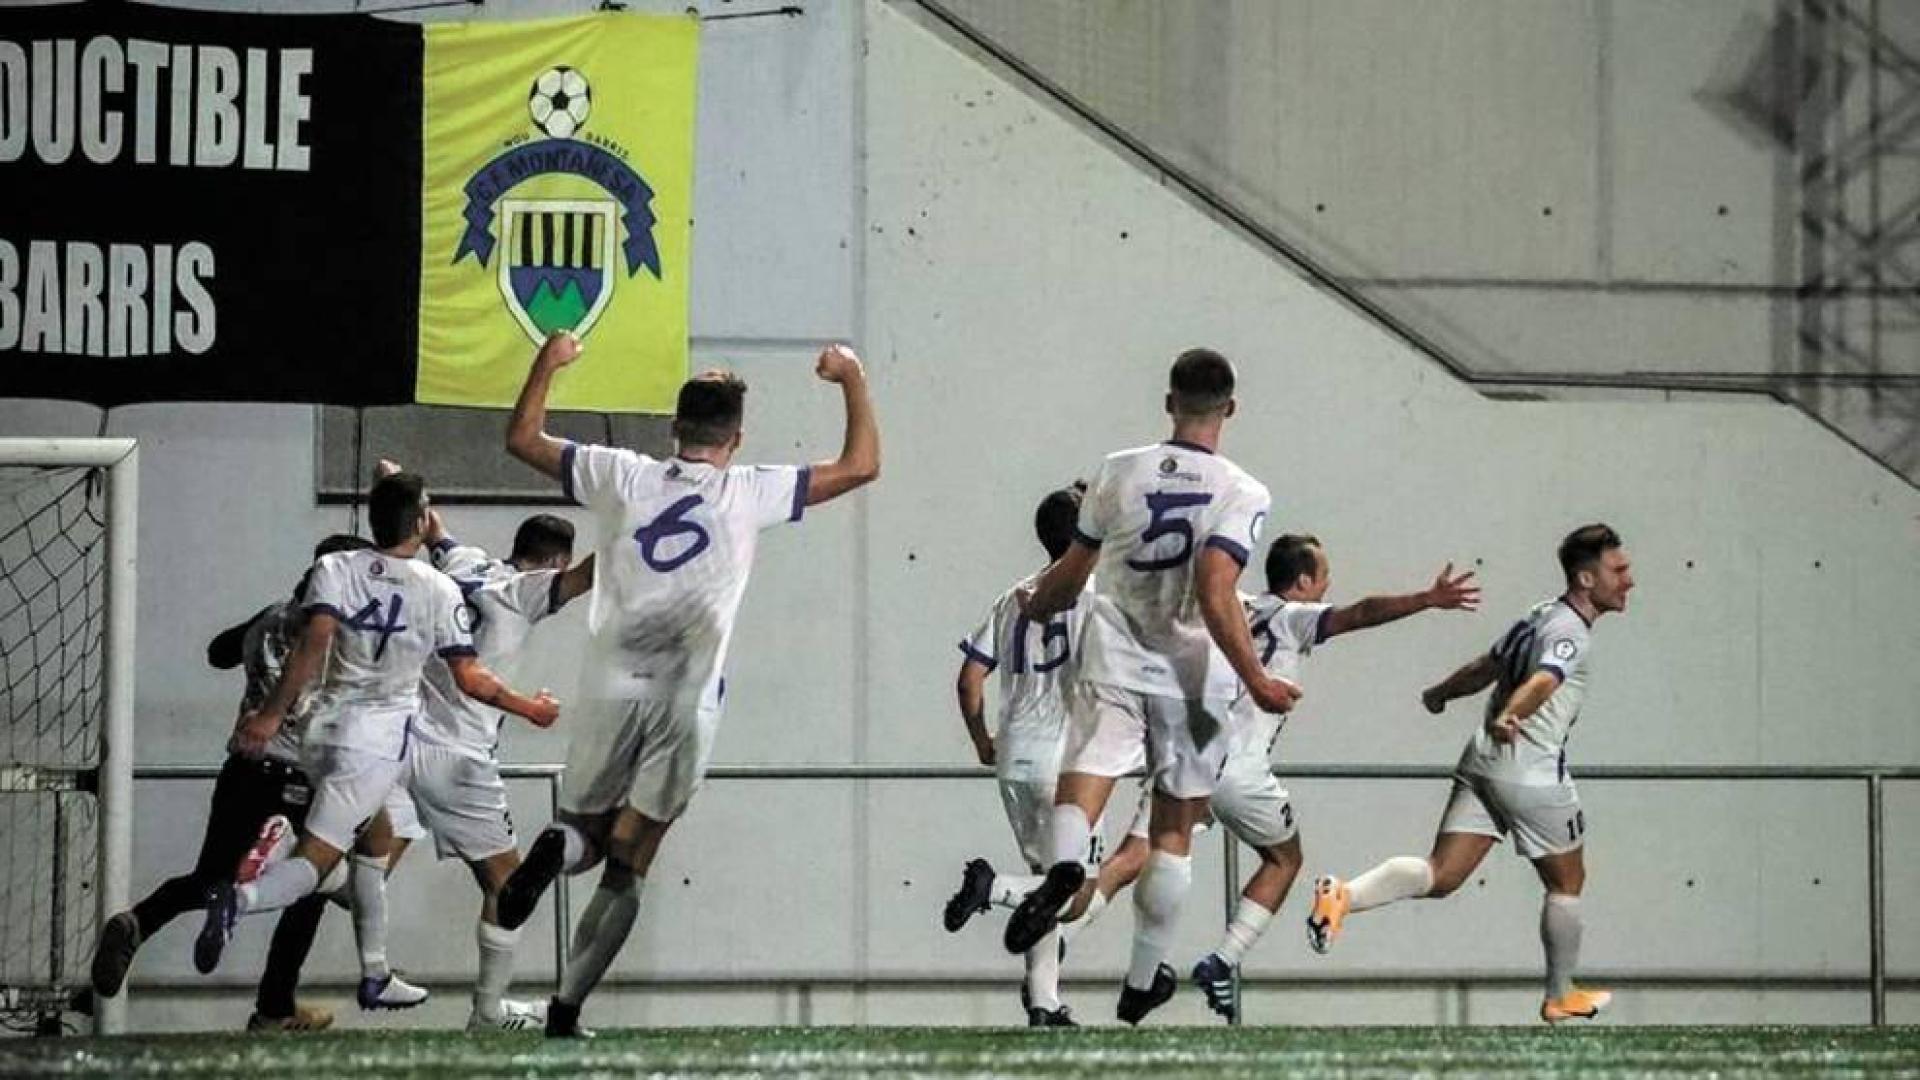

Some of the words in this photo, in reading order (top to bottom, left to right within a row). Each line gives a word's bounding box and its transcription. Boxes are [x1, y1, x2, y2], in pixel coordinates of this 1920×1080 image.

[633, 494, 711, 573] 6
[1124, 489, 1214, 571] 5
[348, 592, 408, 662] 4
[1010, 600, 1077, 673] 15
